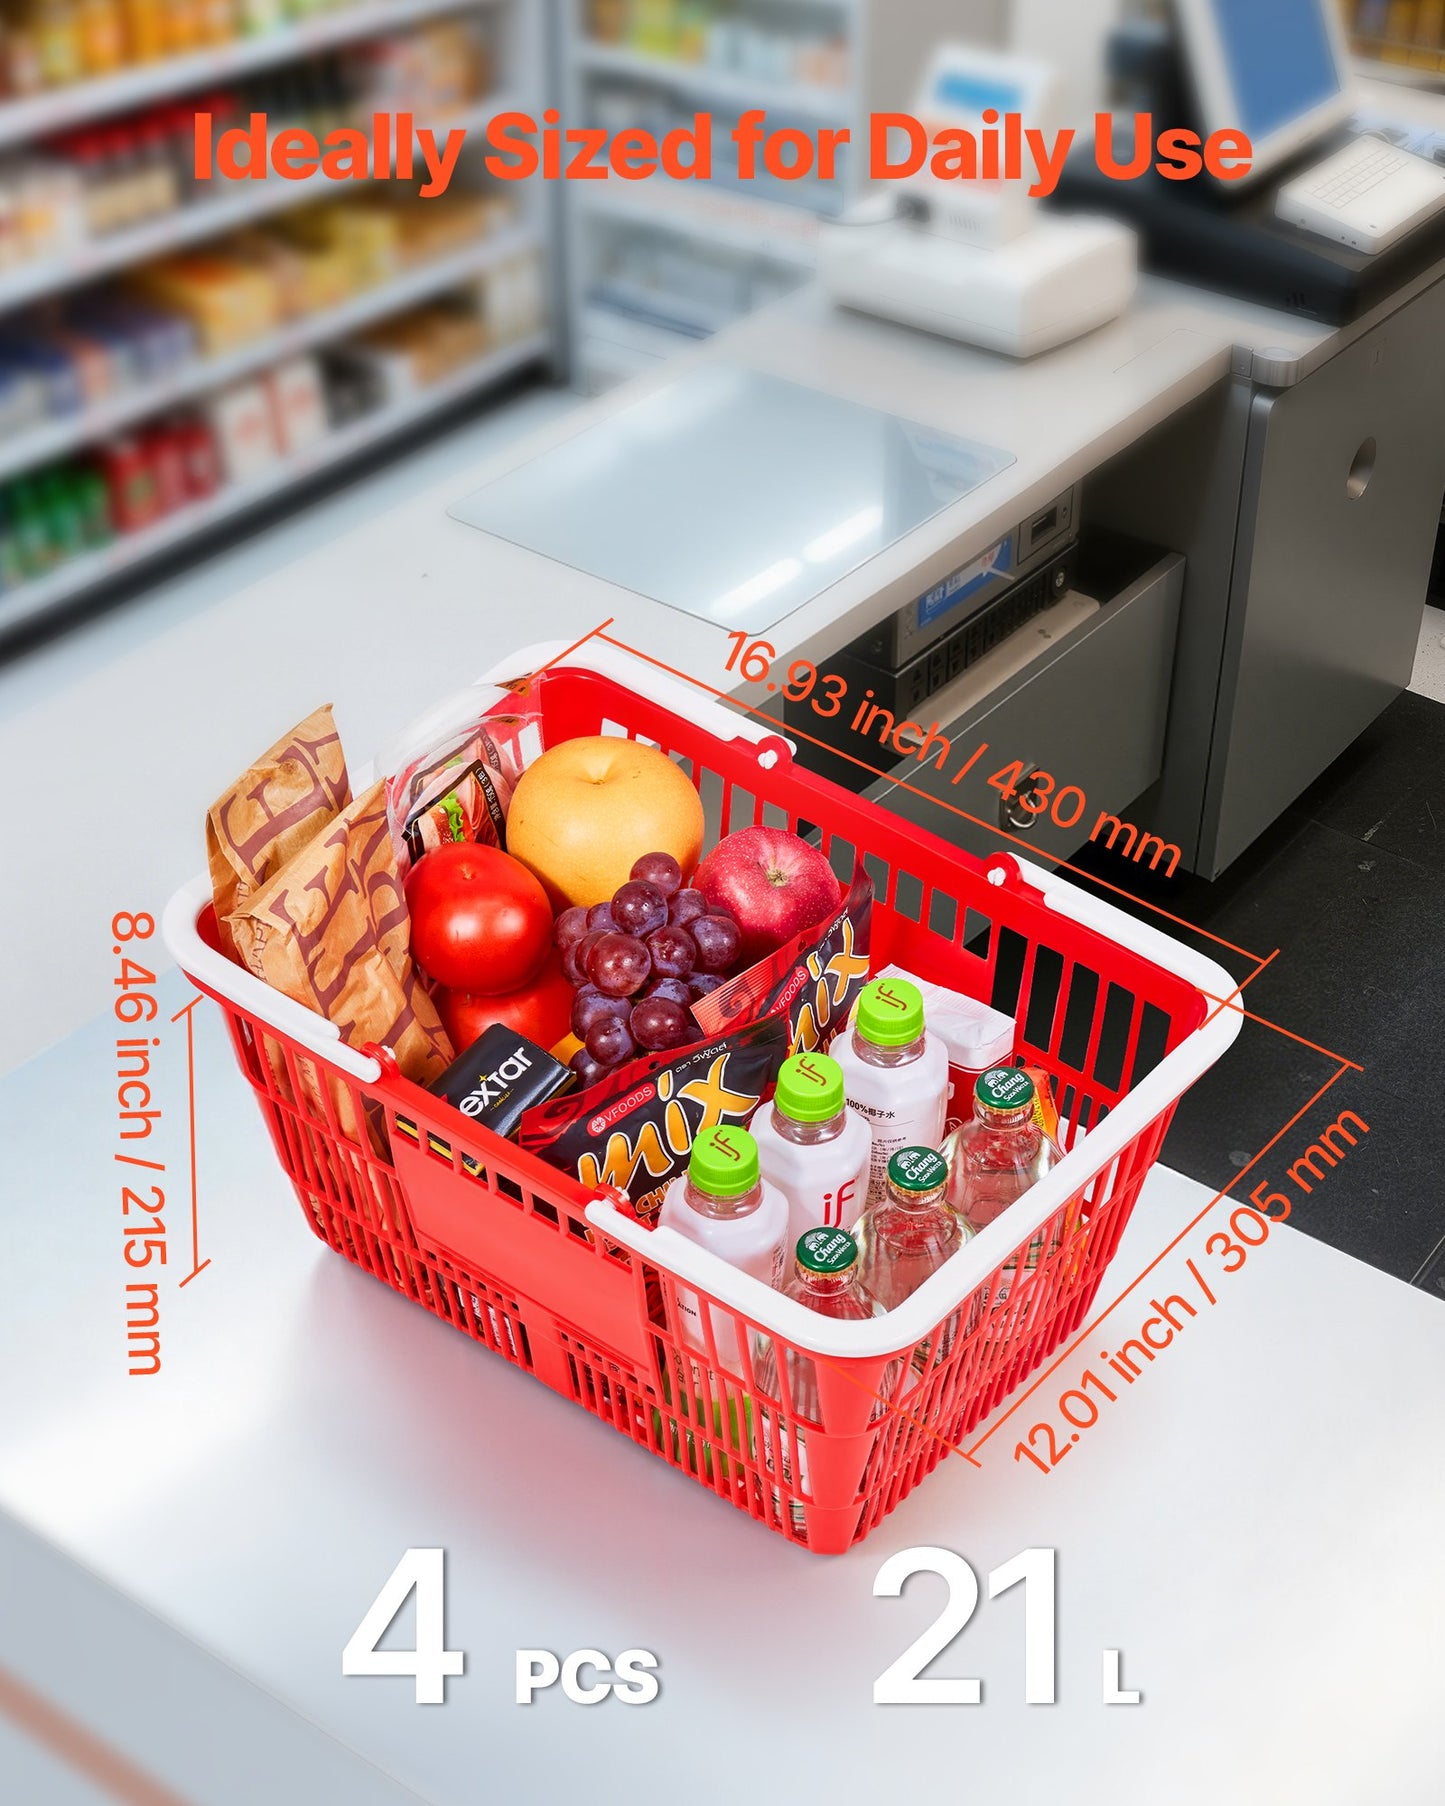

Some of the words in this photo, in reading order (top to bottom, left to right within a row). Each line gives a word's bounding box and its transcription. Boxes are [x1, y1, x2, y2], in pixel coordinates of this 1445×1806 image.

[991, 1072, 1025, 1098] Chang
[604, 1085, 653, 1123] VFOODS
[577, 1052, 761, 1191] mix
[905, 1152, 938, 1180] Chang
[823, 1177, 857, 1228] if
[814, 1233, 847, 1262] Chang
